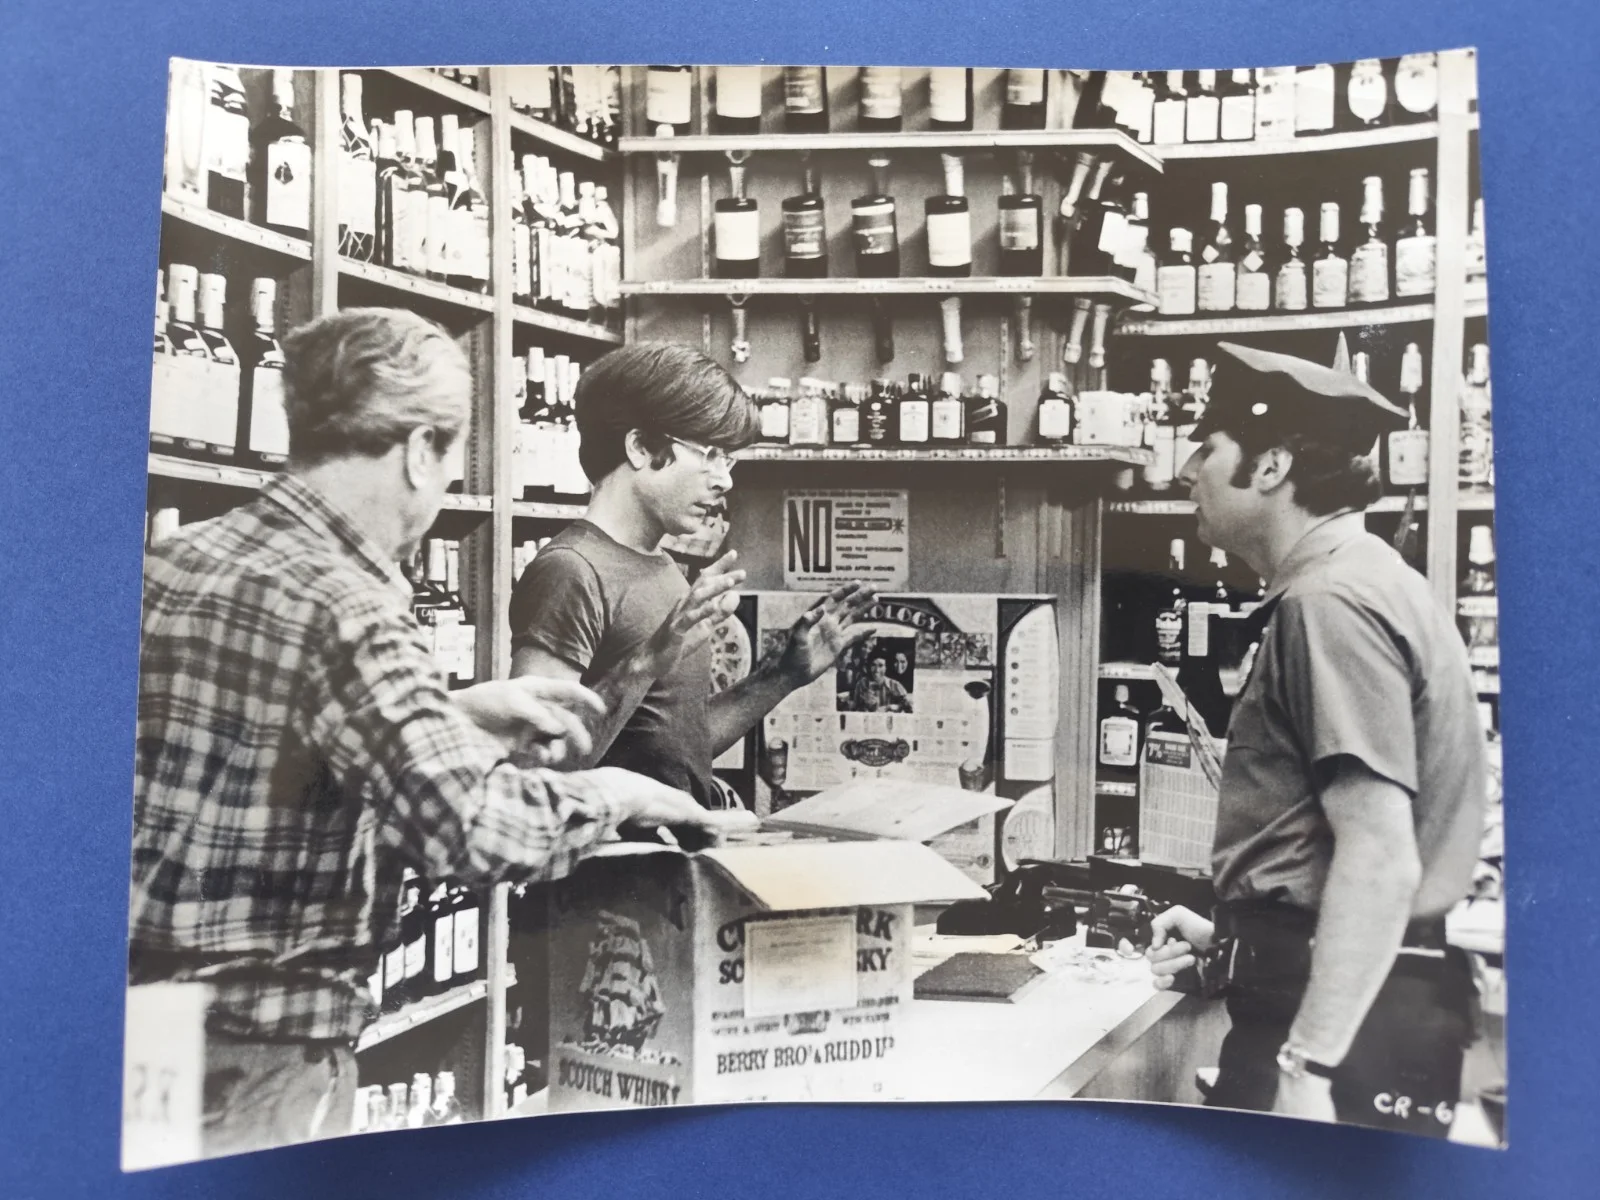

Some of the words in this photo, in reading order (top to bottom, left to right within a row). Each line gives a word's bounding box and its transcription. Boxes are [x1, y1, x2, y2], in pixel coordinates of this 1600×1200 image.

[788, 499, 832, 573] NO
[864, 604, 941, 631] OLOGY
[716, 1048, 768, 1075] BERRY
[824, 1039, 873, 1064] RUDD
[558, 1057, 613, 1098] SCOTCH
